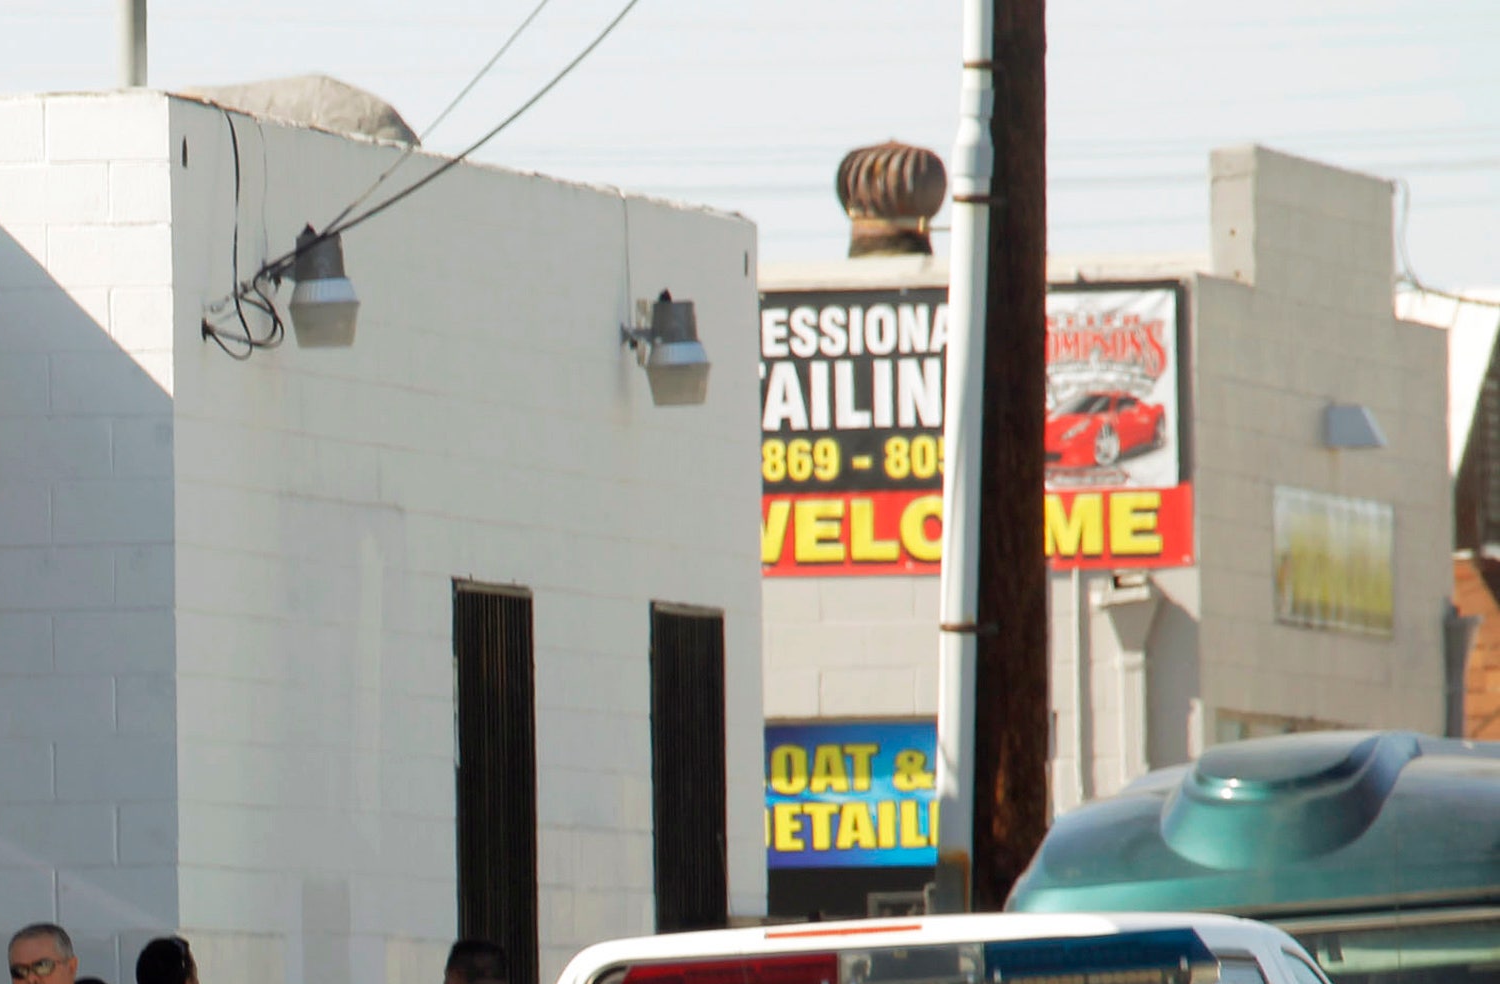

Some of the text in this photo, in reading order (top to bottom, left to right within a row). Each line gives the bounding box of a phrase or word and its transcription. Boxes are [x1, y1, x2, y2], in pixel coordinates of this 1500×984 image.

[760, 358, 942, 430] AILIN
[885, 435, 946, 479] 80
[763, 743, 879, 796] OAT
[764, 799, 939, 852] ETAIL
